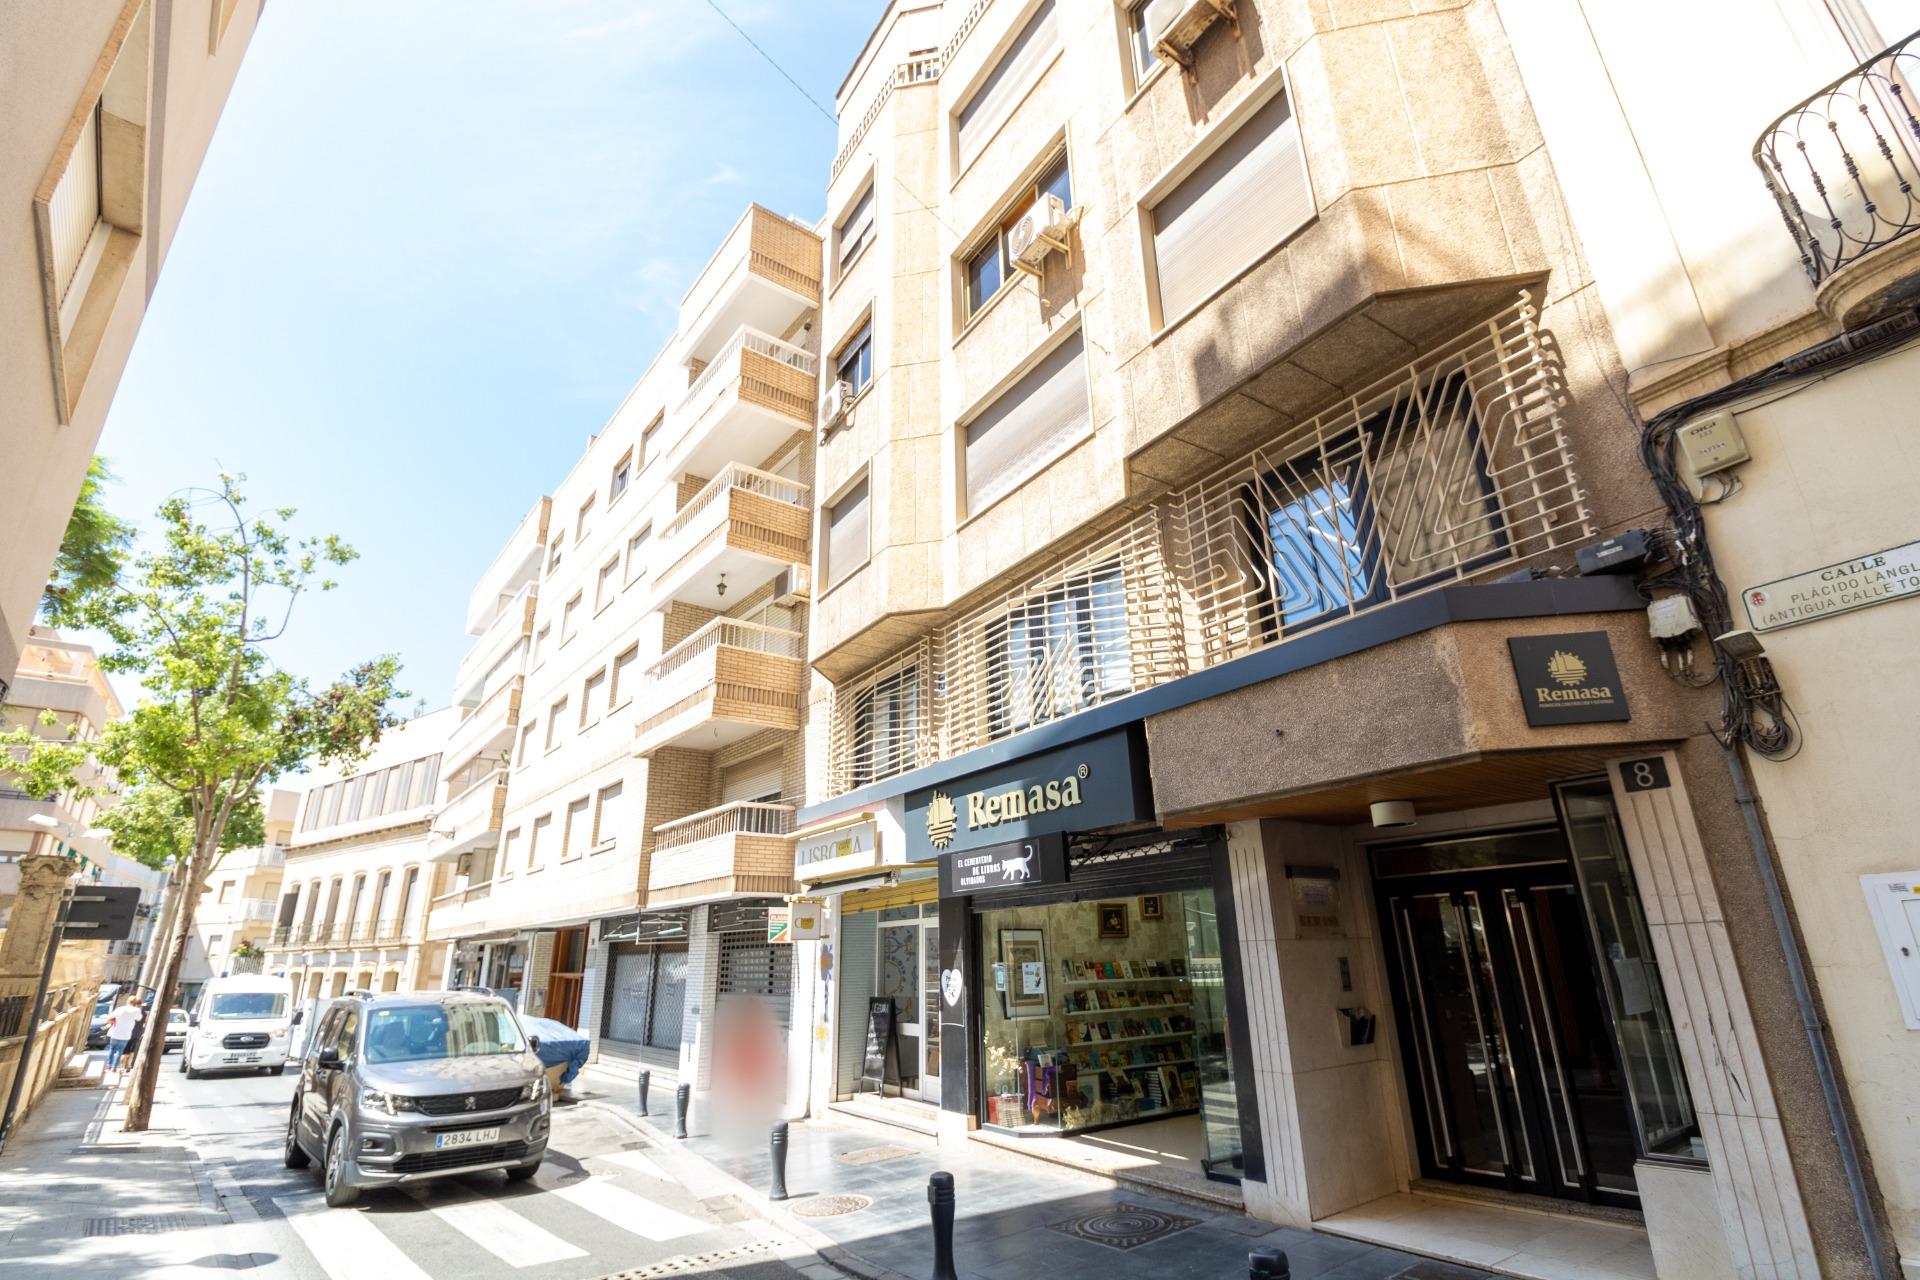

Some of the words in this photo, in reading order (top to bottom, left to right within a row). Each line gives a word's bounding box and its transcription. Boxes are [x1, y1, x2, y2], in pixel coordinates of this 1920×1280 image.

[1821, 556, 1887, 582] CALLE
[1762, 599, 1836, 626] (ANTIGUA
[1841, 583, 1893, 604] CALLE
[1536, 686, 1612, 702] Remasa
[1633, 762, 1654, 787] 8
[957, 860, 964, 868] EL
[972, 866, 980, 876] DE
[980, 863, 1000, 875] LIBROS
[444, 1132, 472, 1146] 2834
[476, 1129, 497, 1142] LHJ
